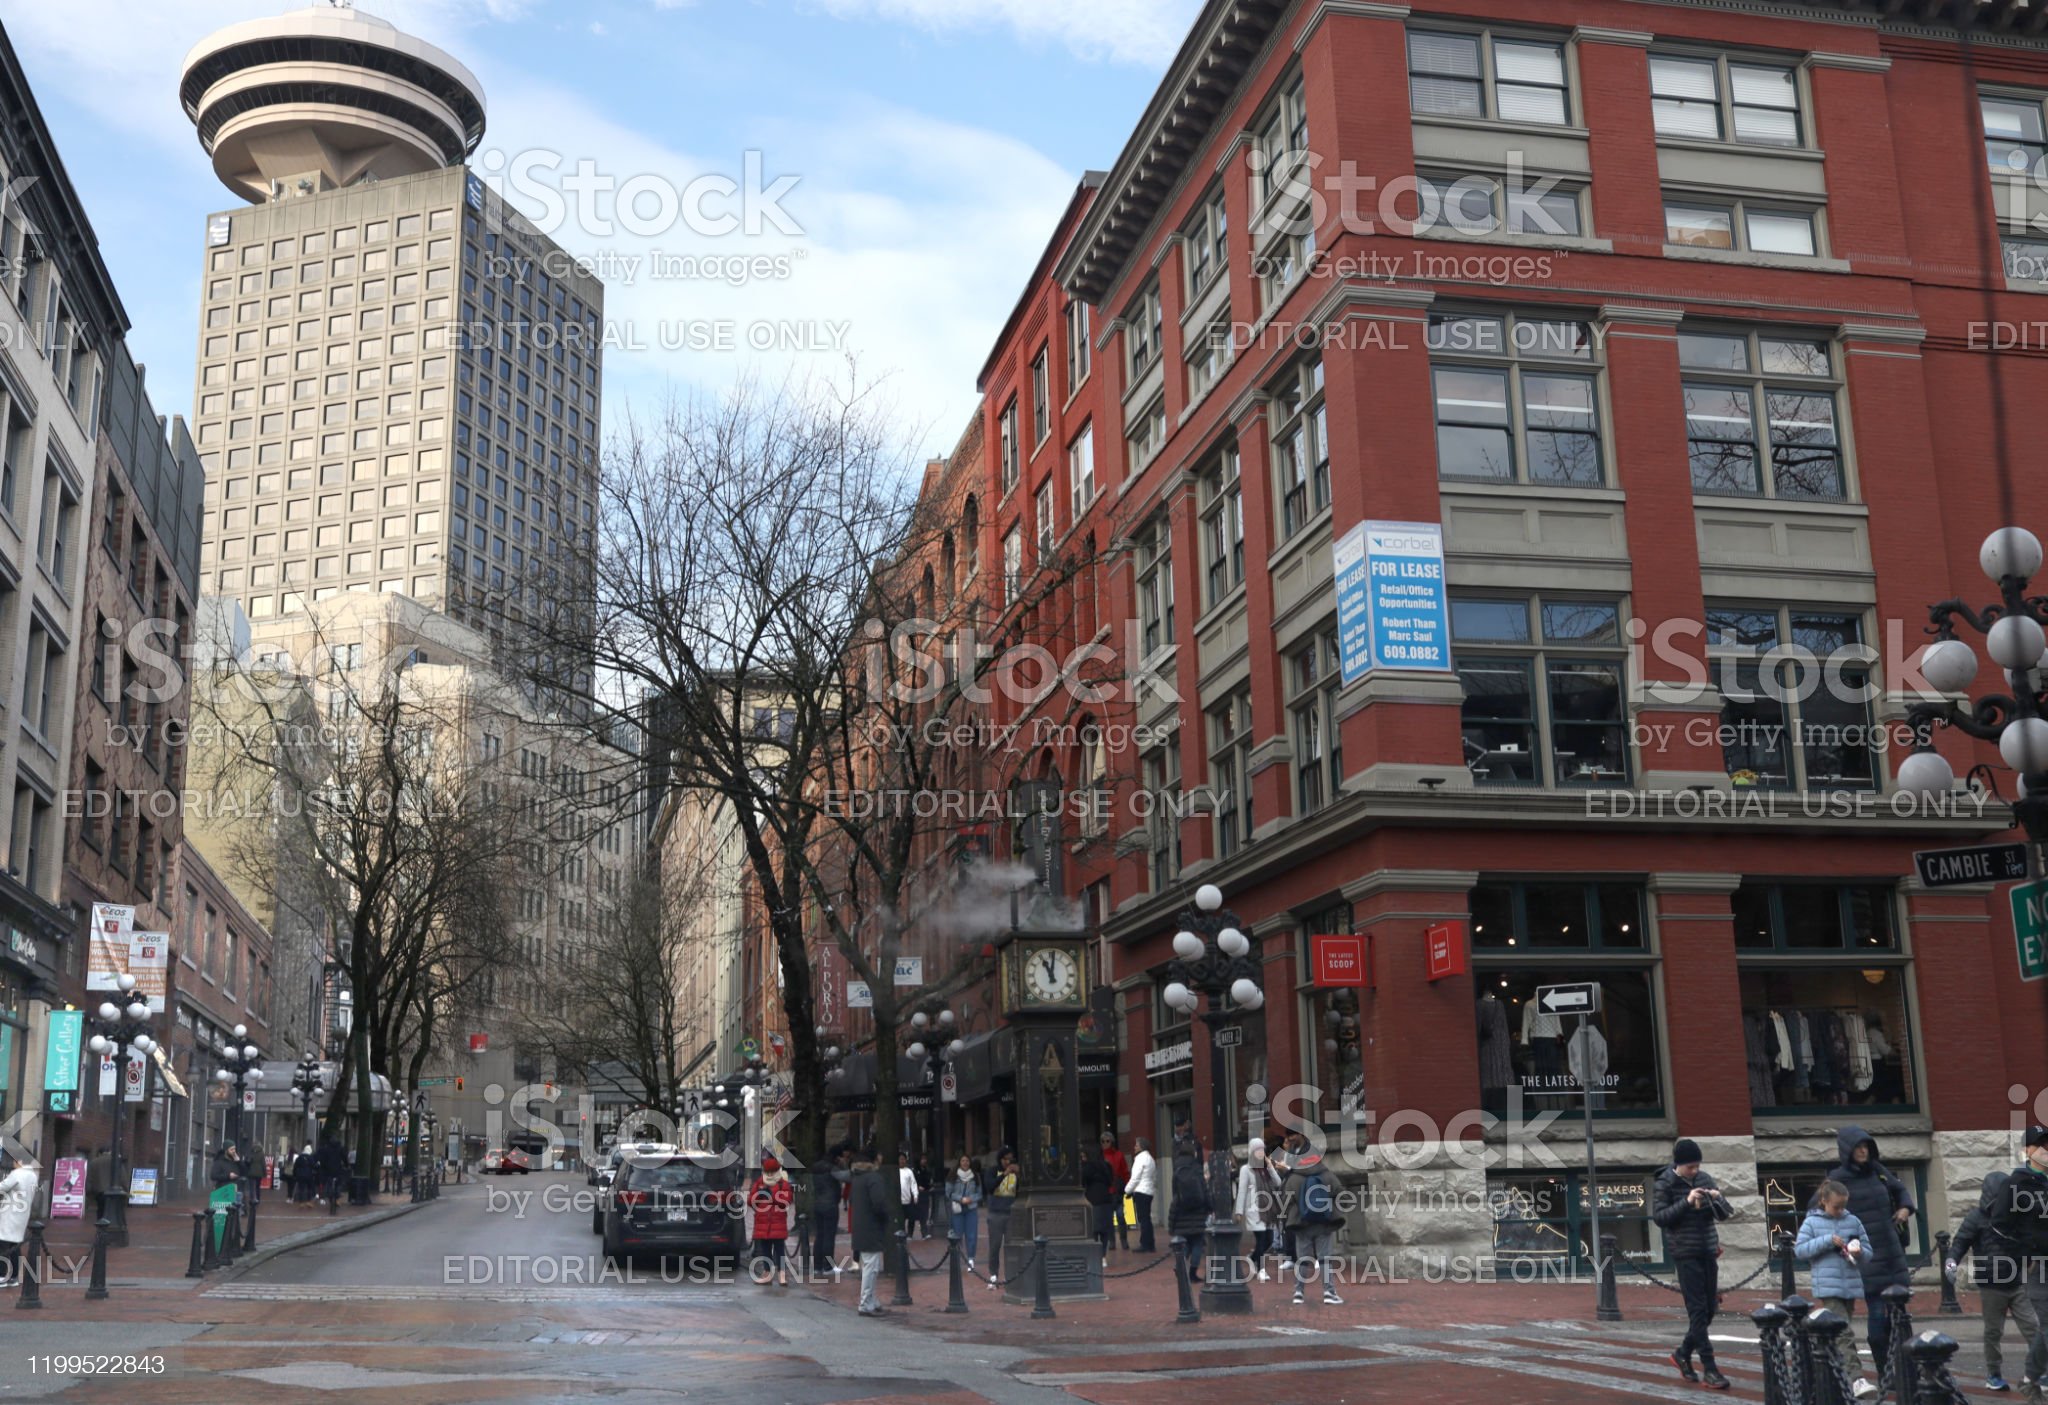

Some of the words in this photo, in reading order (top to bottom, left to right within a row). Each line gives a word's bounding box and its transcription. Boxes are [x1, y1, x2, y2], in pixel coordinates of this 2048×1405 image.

[1384, 536, 1437, 551] corbel
[1372, 561, 1397, 576] FOR
[1400, 563, 1441, 579] LEASE
[1380, 583, 1434, 596] Retail/Office
[1379, 597, 1437, 610] Opportunities
[1382, 617, 1411, 628] Robert
[1413, 618, 1437, 629] Tham
[1389, 630, 1411, 641] Marc
[1413, 630, 1433, 642] Saul
[1384, 645, 1440, 660] 609.0882
[1926, 853, 1993, 881] CAMBIE
[2005, 851, 2016, 864] ST
[822, 946, 831, 968] AL
[1329, 960, 1354, 968] SCOOP
[895, 967, 913, 975] ELC
[821, 971, 833, 1024] PORTO
[1076, 1063, 1111, 1073] MMOLITE
[1521, 1074, 1541, 1087] THE
[1582, 1185, 1645, 1196] SEAKERS
